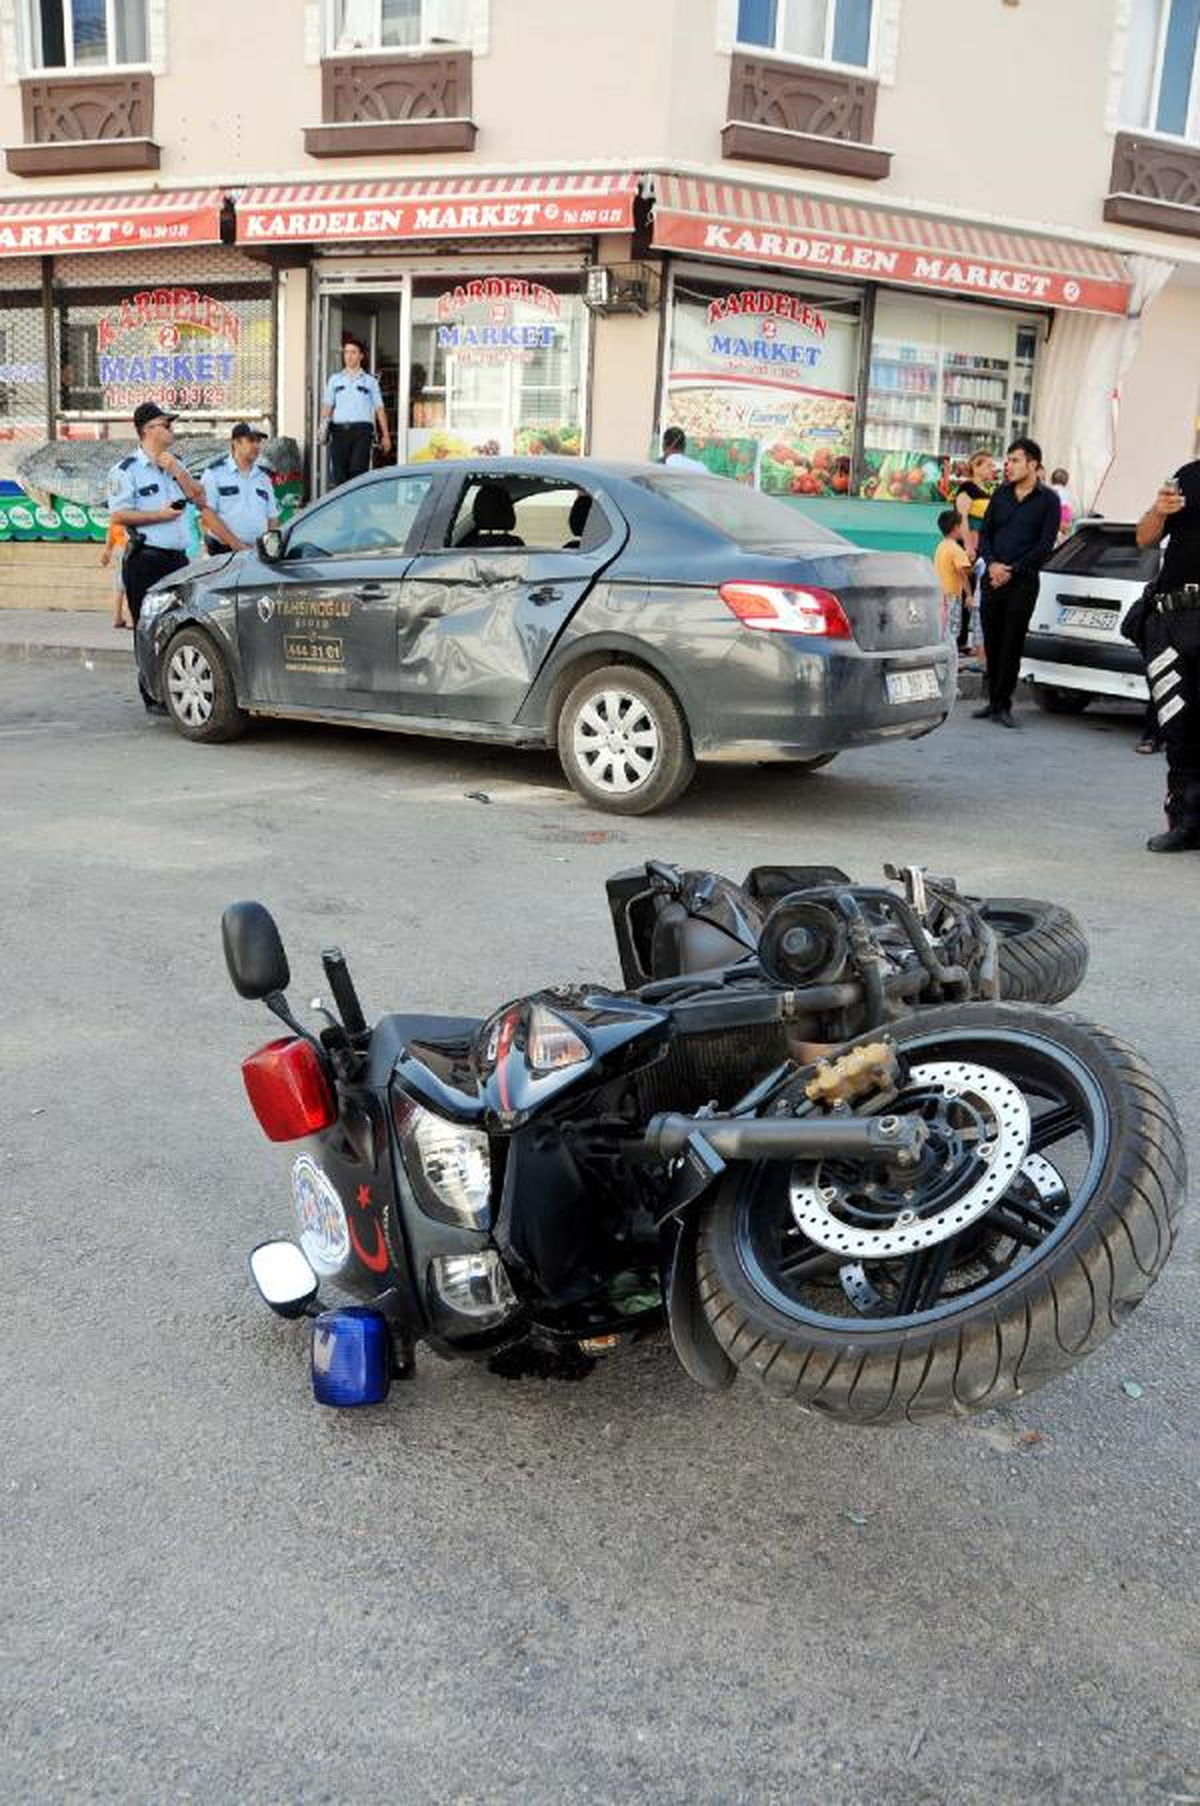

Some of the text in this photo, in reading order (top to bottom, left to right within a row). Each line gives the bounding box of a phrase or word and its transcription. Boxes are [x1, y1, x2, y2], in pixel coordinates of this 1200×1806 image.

[246, 209, 402, 238] KARDELEN
[413, 203, 541, 230] MARKET
[702, 224, 901, 274] KARDELEN
[911, 256, 1052, 300] MARKET
[436, 277, 562, 320] KARDELEN
[706, 291, 829, 338] KARDELEN
[97, 288, 241, 352] KARDELEN
[162, 326, 178, 349] 2
[437, 324, 556, 349] MARKET
[763, 319, 777, 338] 2
[99, 353, 237, 385] MARKET
[710, 334, 823, 369] MARKET
